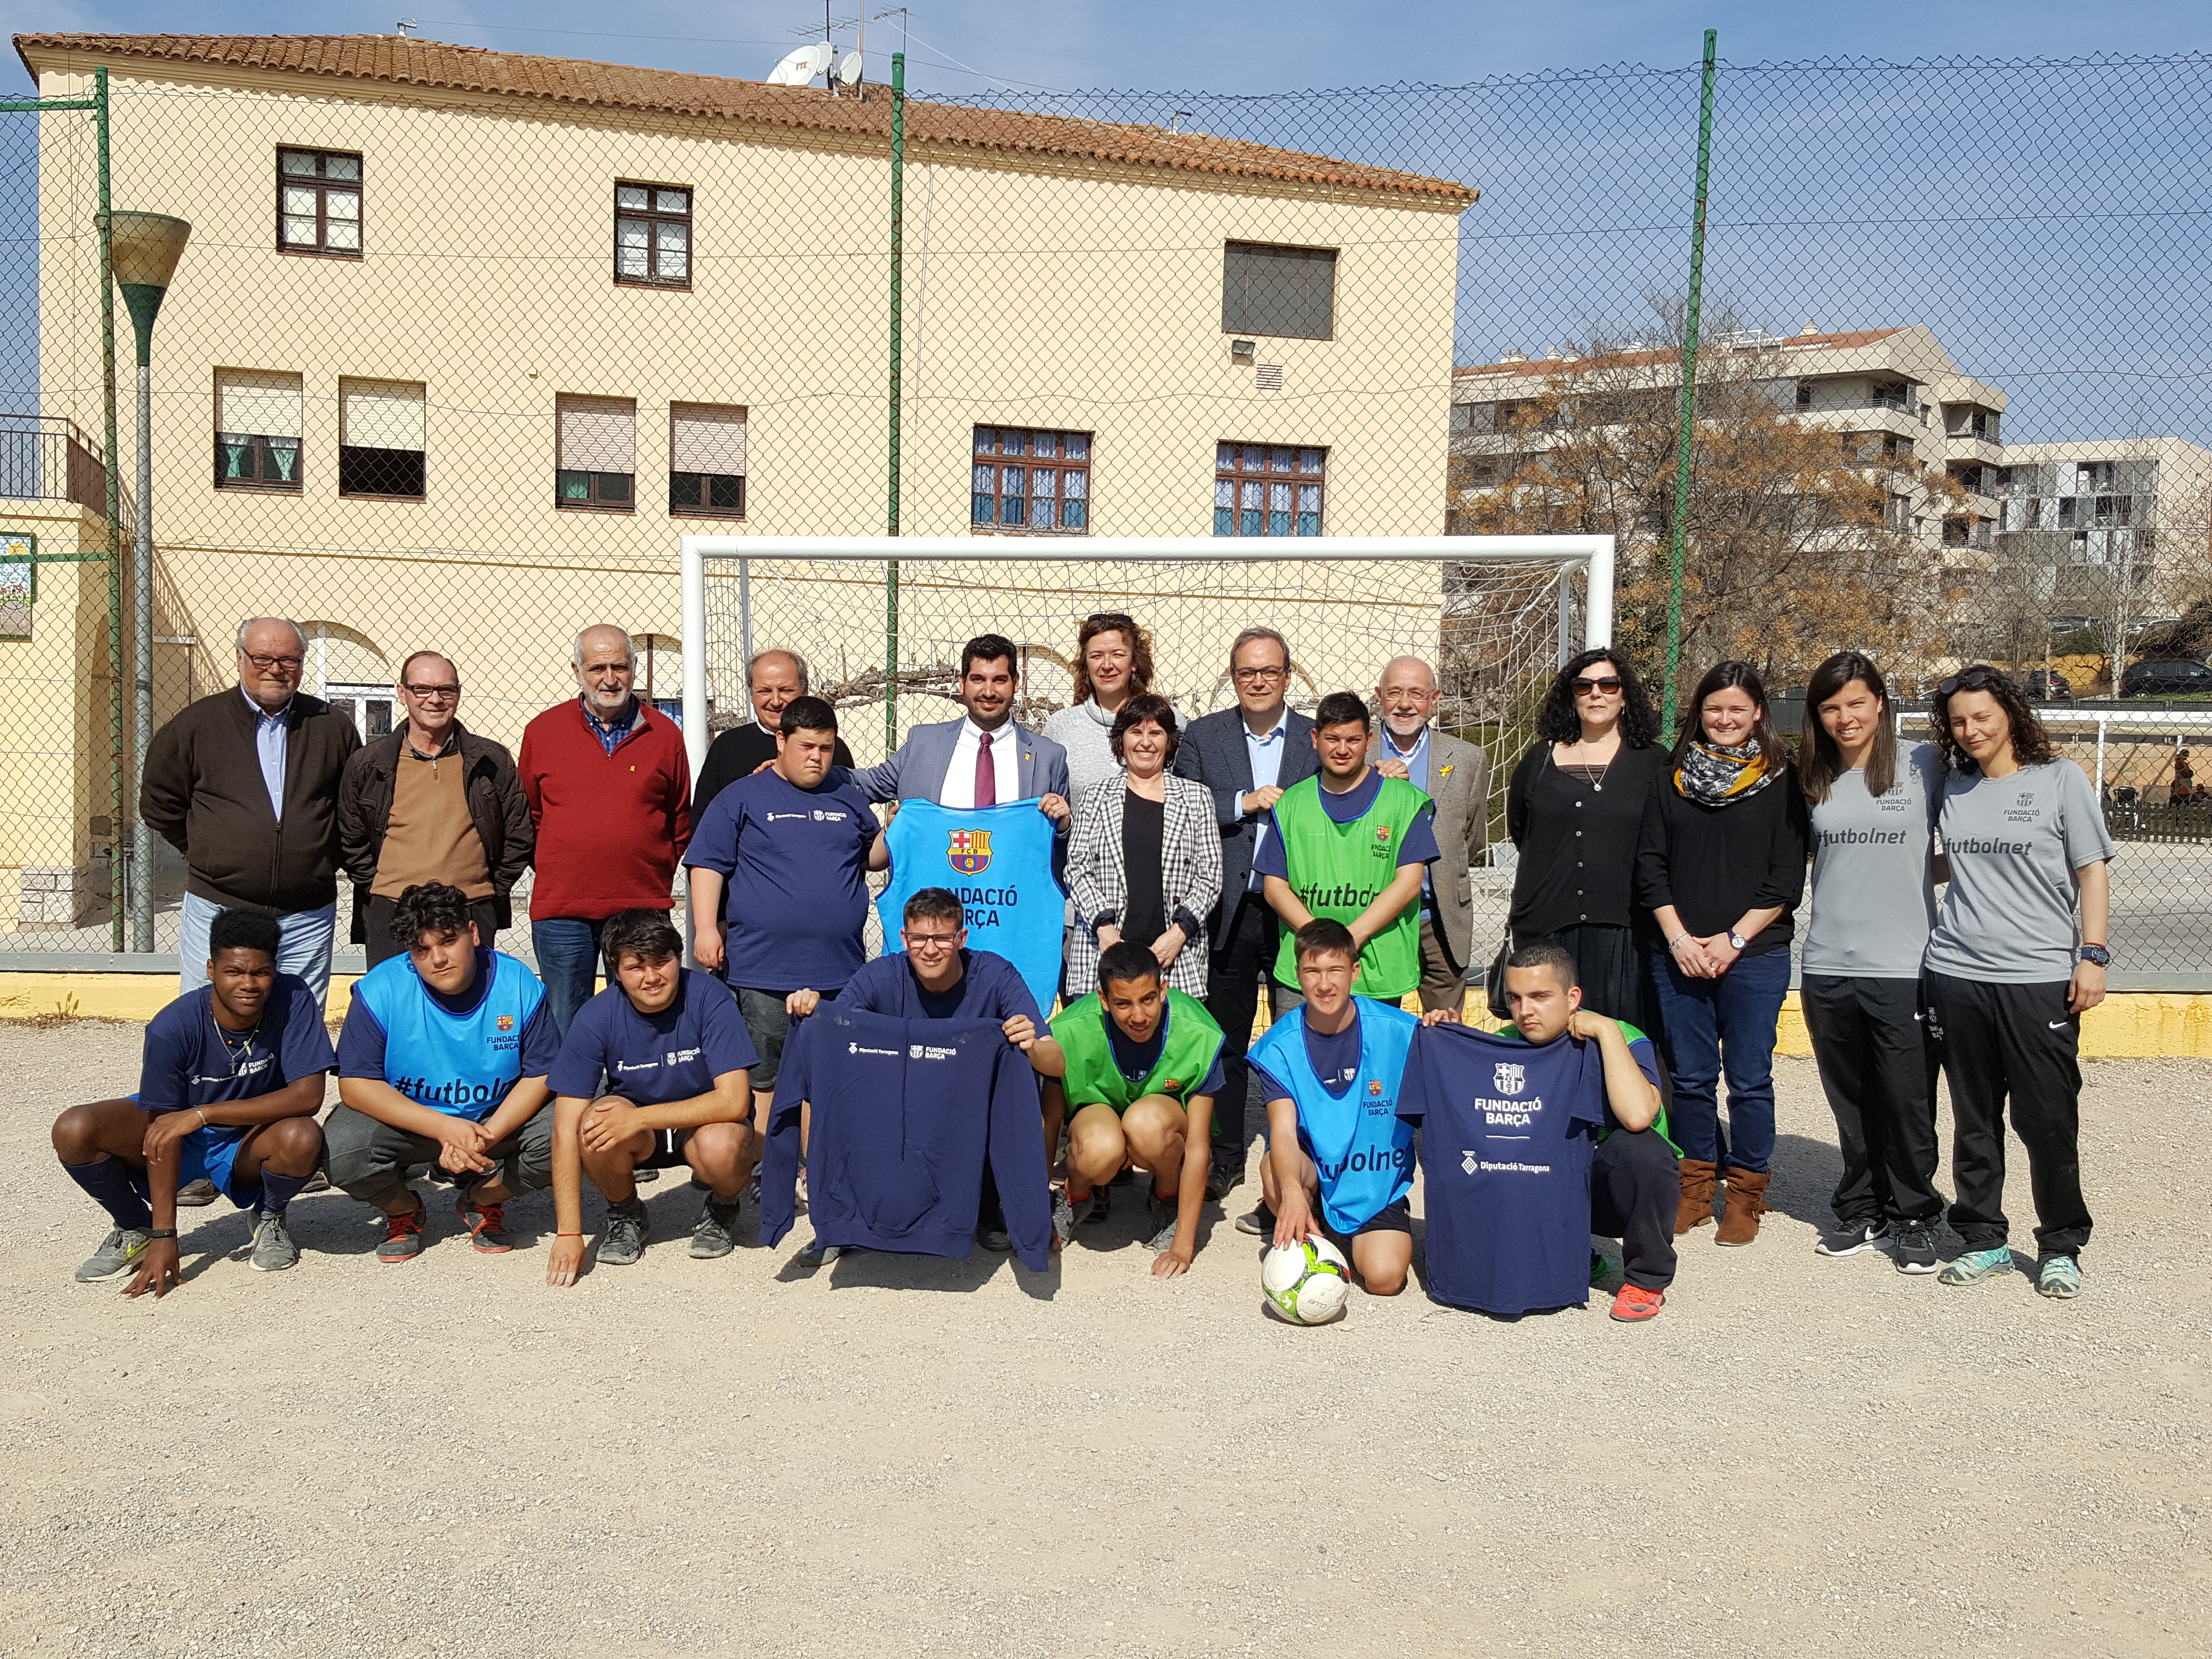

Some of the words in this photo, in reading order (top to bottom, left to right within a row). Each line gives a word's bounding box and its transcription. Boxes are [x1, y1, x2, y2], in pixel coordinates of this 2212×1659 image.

[965, 909, 1000, 929] RÇA
[494, 1043, 519, 1051] BARÇA
[926, 1047, 956, 1055] FUNDACIÓ
[1363, 1098, 1392, 1108] FUNDACIÓ
[1475, 1097, 1542, 1113] FUNDACIÓ
[1368, 1108, 1389, 1117] BARÇA
[1486, 1112, 1531, 1127] BARÇA
[1480, 1161, 1518, 1172] Diputació
[1518, 1163, 1550, 1174] Tarragona
